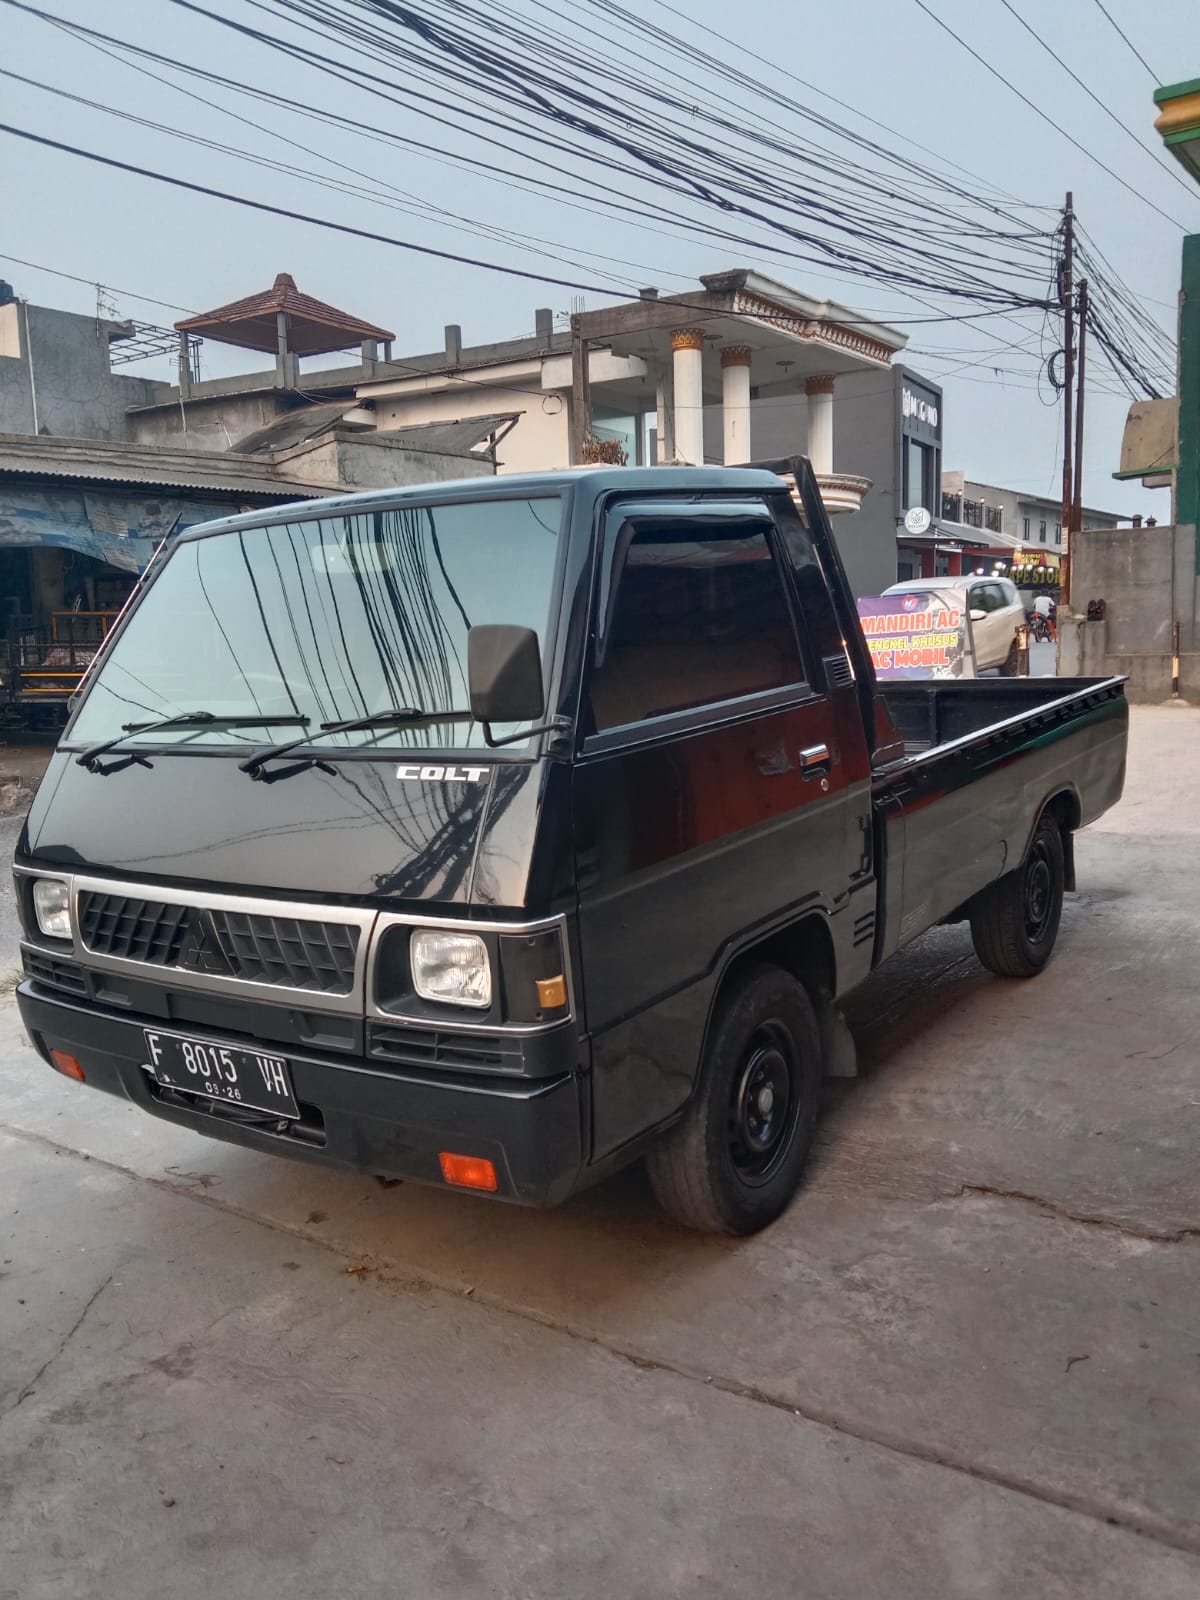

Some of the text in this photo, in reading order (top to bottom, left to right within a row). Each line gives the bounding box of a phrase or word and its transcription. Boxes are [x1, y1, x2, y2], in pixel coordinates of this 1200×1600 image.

[861, 609, 960, 635] MANDIRI AC
[867, 632, 958, 653] ENGKEL KHUSUS
[893, 646, 950, 669] MOBIL
[396, 765, 490, 782] COLT
[148, 1034, 289, 1097] F 8015 VH
